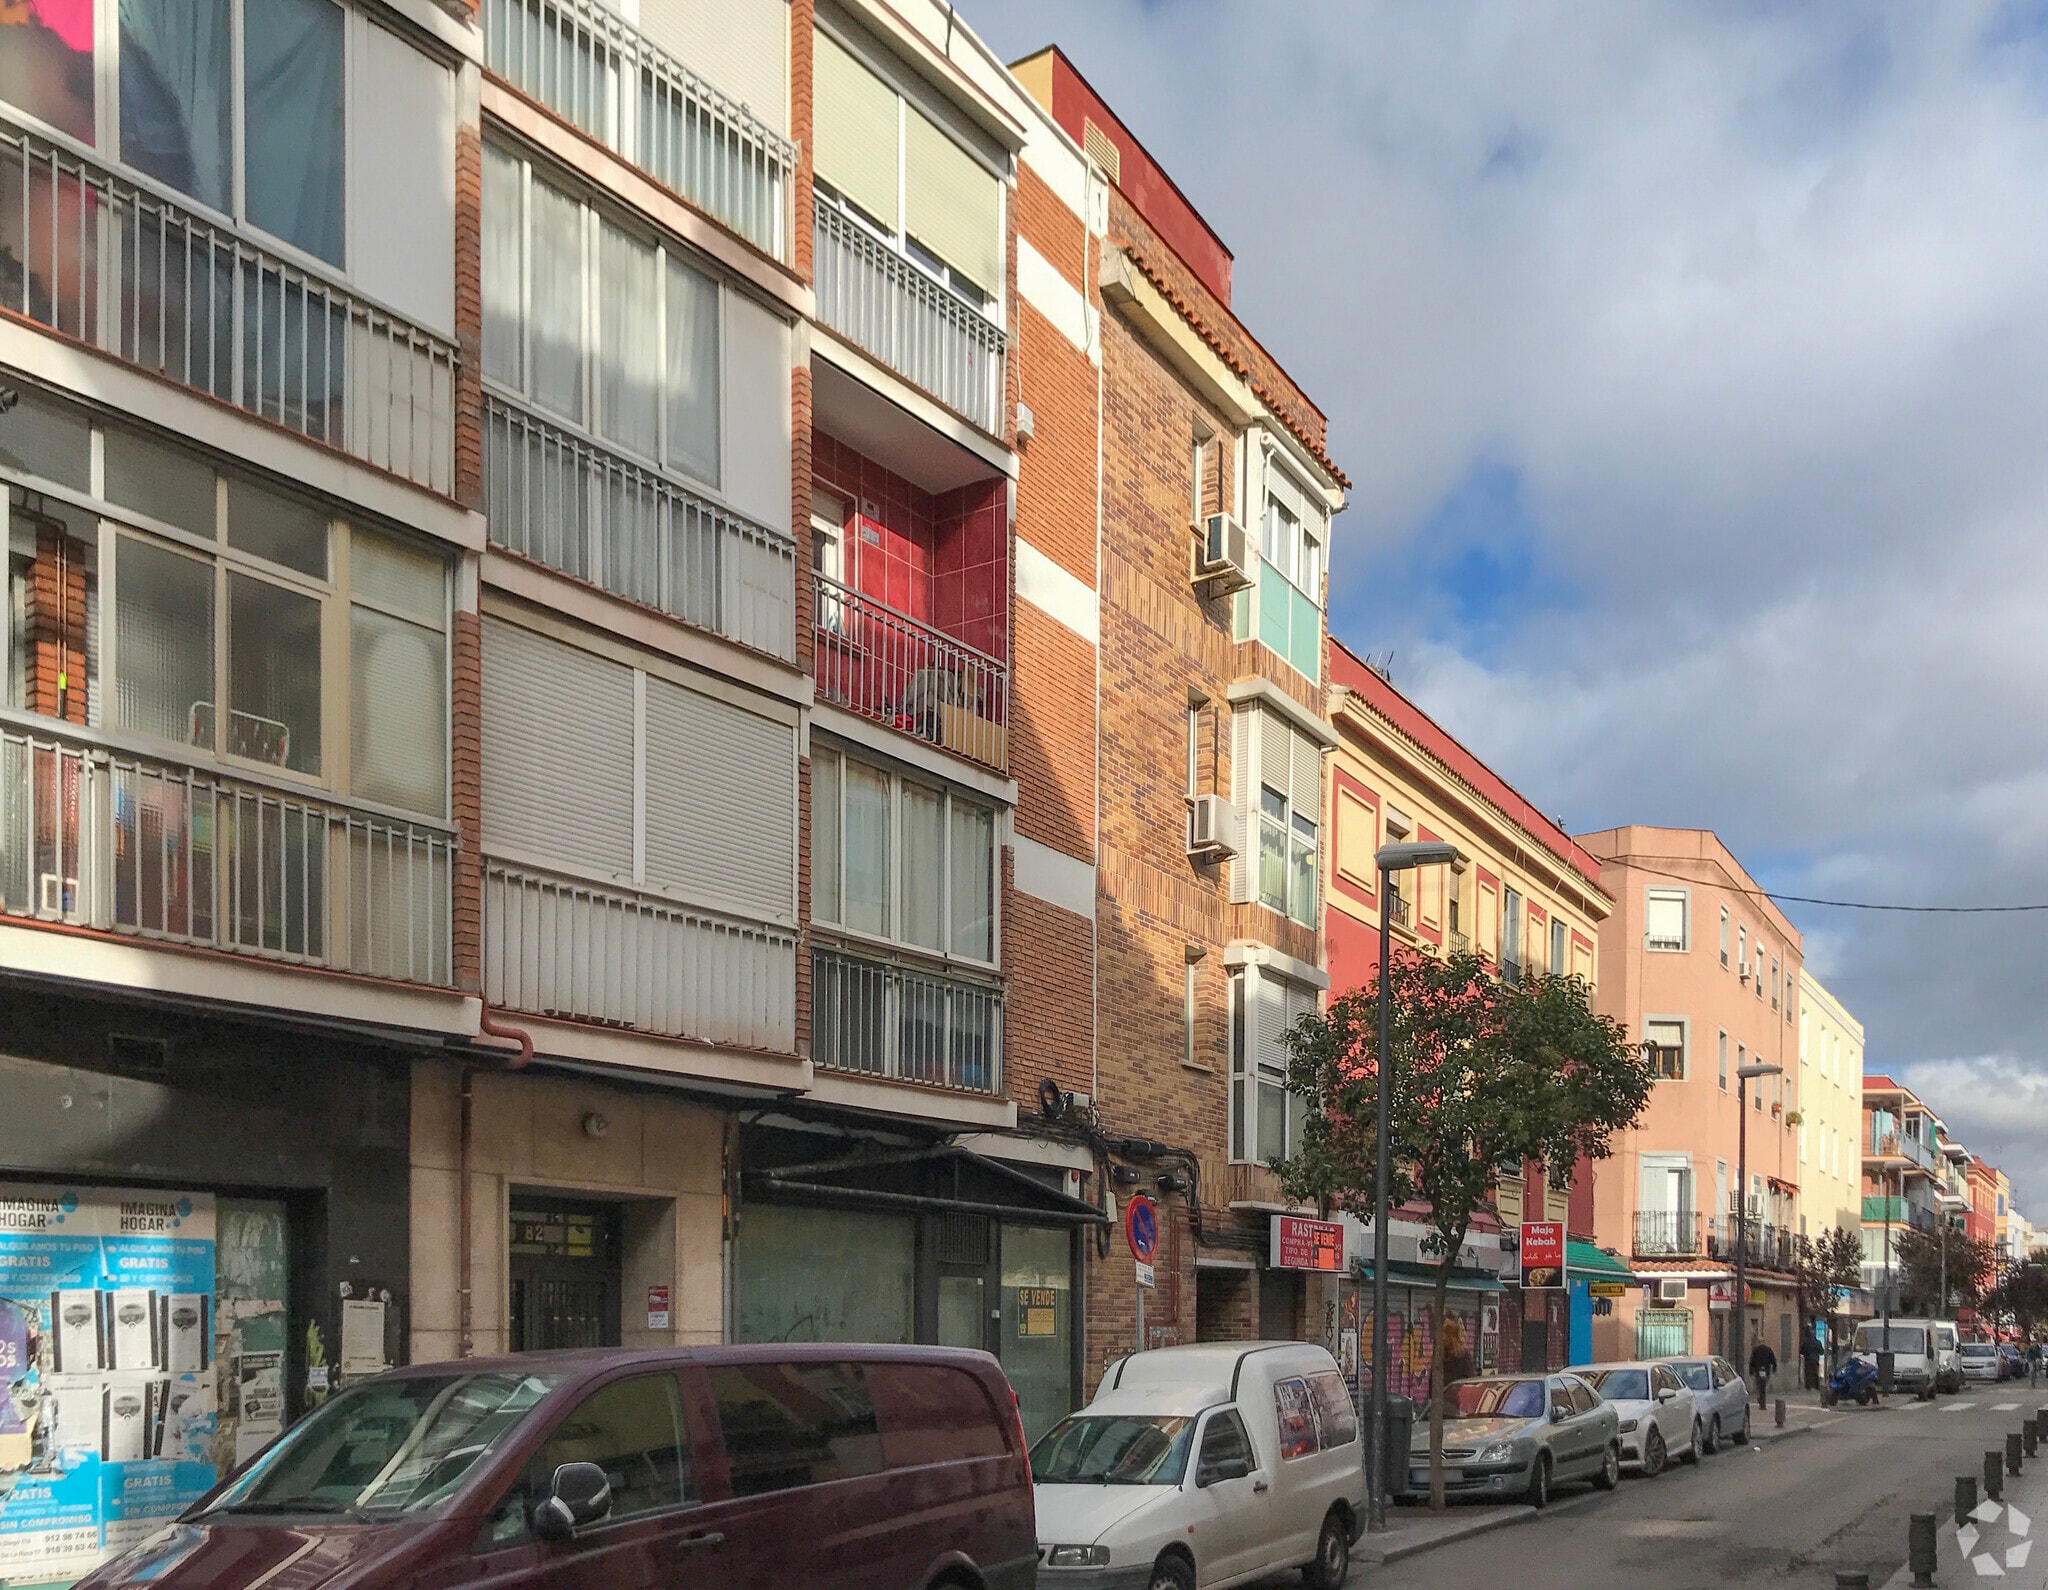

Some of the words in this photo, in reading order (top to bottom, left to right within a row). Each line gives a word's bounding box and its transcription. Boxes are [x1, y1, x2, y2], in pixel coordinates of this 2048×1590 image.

[120, 1201, 176, 1216] IMAGINA
[120, 1217, 164, 1231] HOGAR
[525, 1225, 543, 1241] 82
[1526, 1237, 1556, 1246] Kebab
[0, 1255, 51, 1267] GRATIS
[119, 1257, 169, 1269] GRATIS
[1020, 1289, 1029, 1306] SE
[1031, 1289, 1055, 1306] VENDE
[124, 1475, 172, 1489] GRATIS
[21, 1513, 92, 1528] COMPROMISO
[44, 1534, 60, 1542] 912
